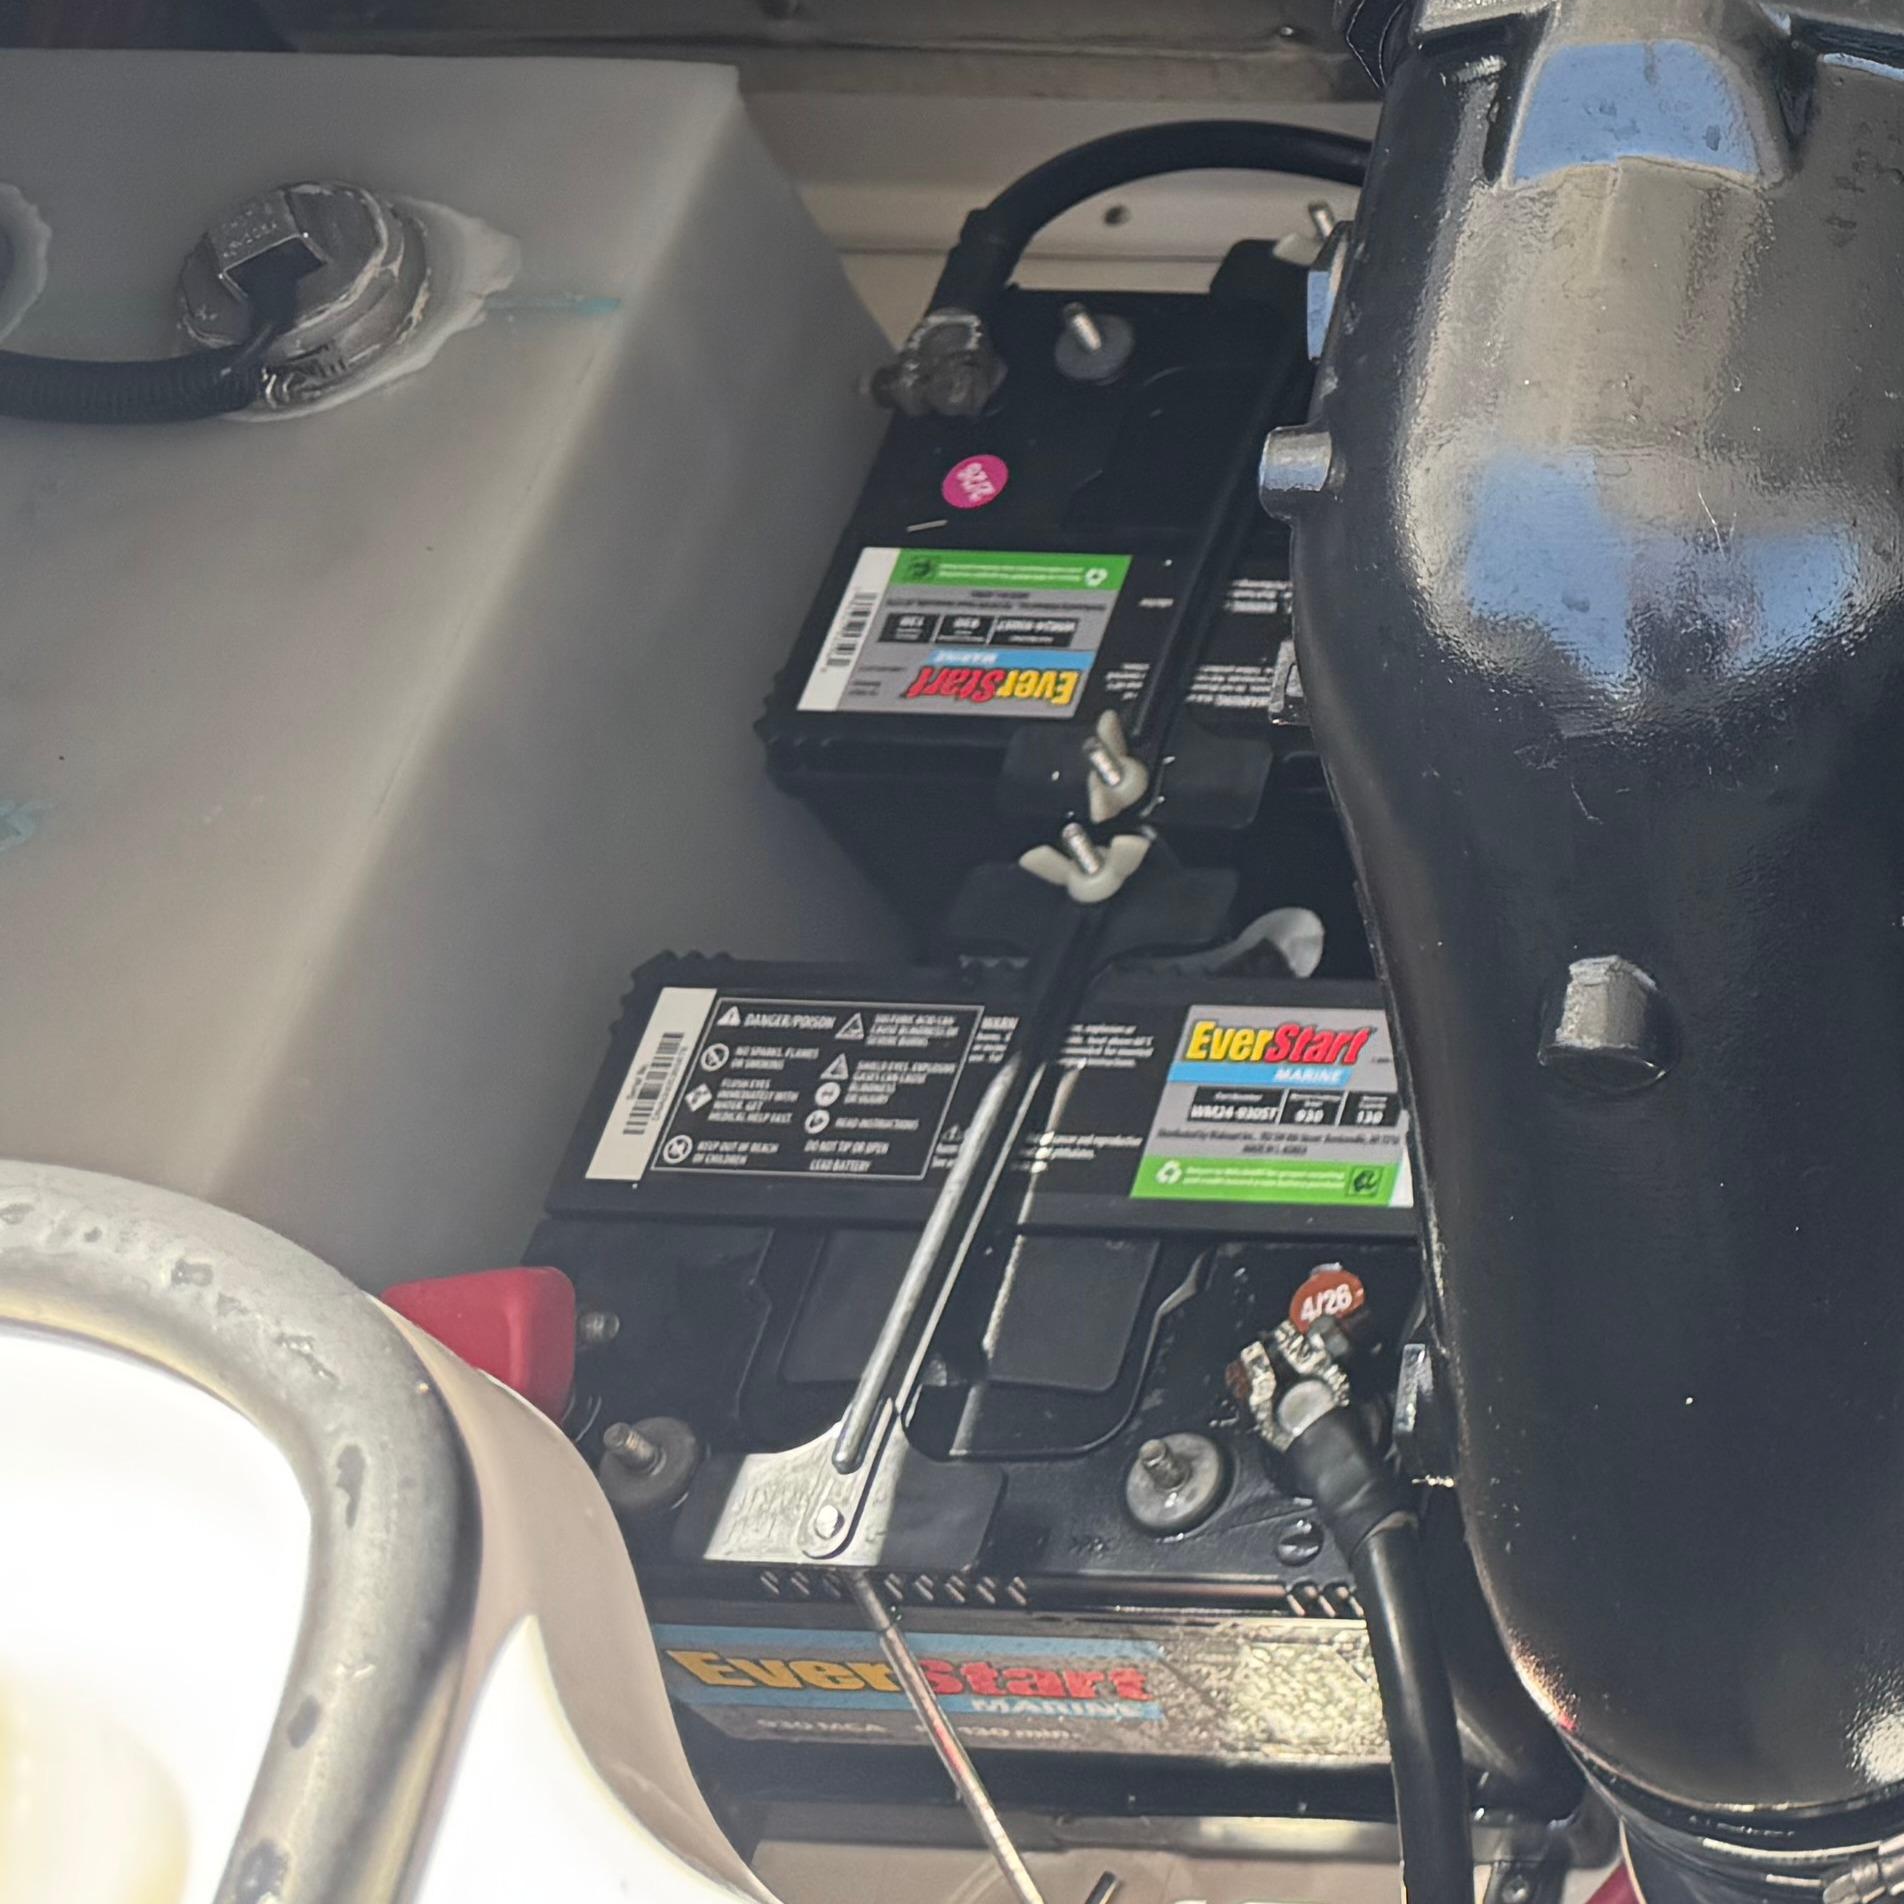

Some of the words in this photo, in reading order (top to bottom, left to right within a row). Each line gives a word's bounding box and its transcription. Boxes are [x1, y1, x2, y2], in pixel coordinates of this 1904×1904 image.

[904, 667, 1081, 705] EverStart
[744, 1013, 837, 1029] DANGER/POISON
[1184, 1019, 1372, 1065] EverStart
[1272, 1068, 1343, 1084] MARINE
[665, 1649, 1151, 1703] EverStart
